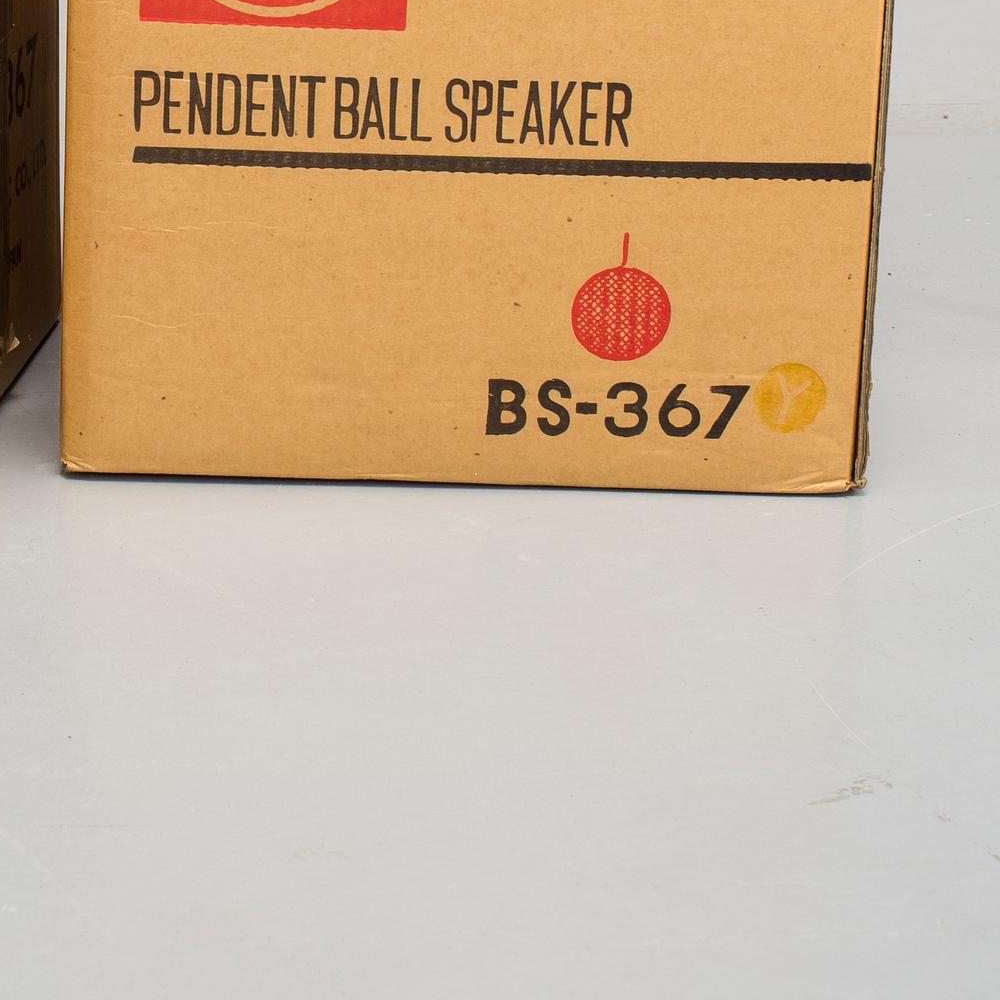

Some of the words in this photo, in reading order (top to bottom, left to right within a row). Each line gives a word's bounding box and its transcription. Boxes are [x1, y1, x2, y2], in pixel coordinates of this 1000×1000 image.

[133, 69, 326, 138] PENDENT
[333, 76, 433, 142] BALL
[444, 78, 634, 147] SPEAKER
[485, 378, 751, 439] BS-367
[774, 371, 813, 426] Y
